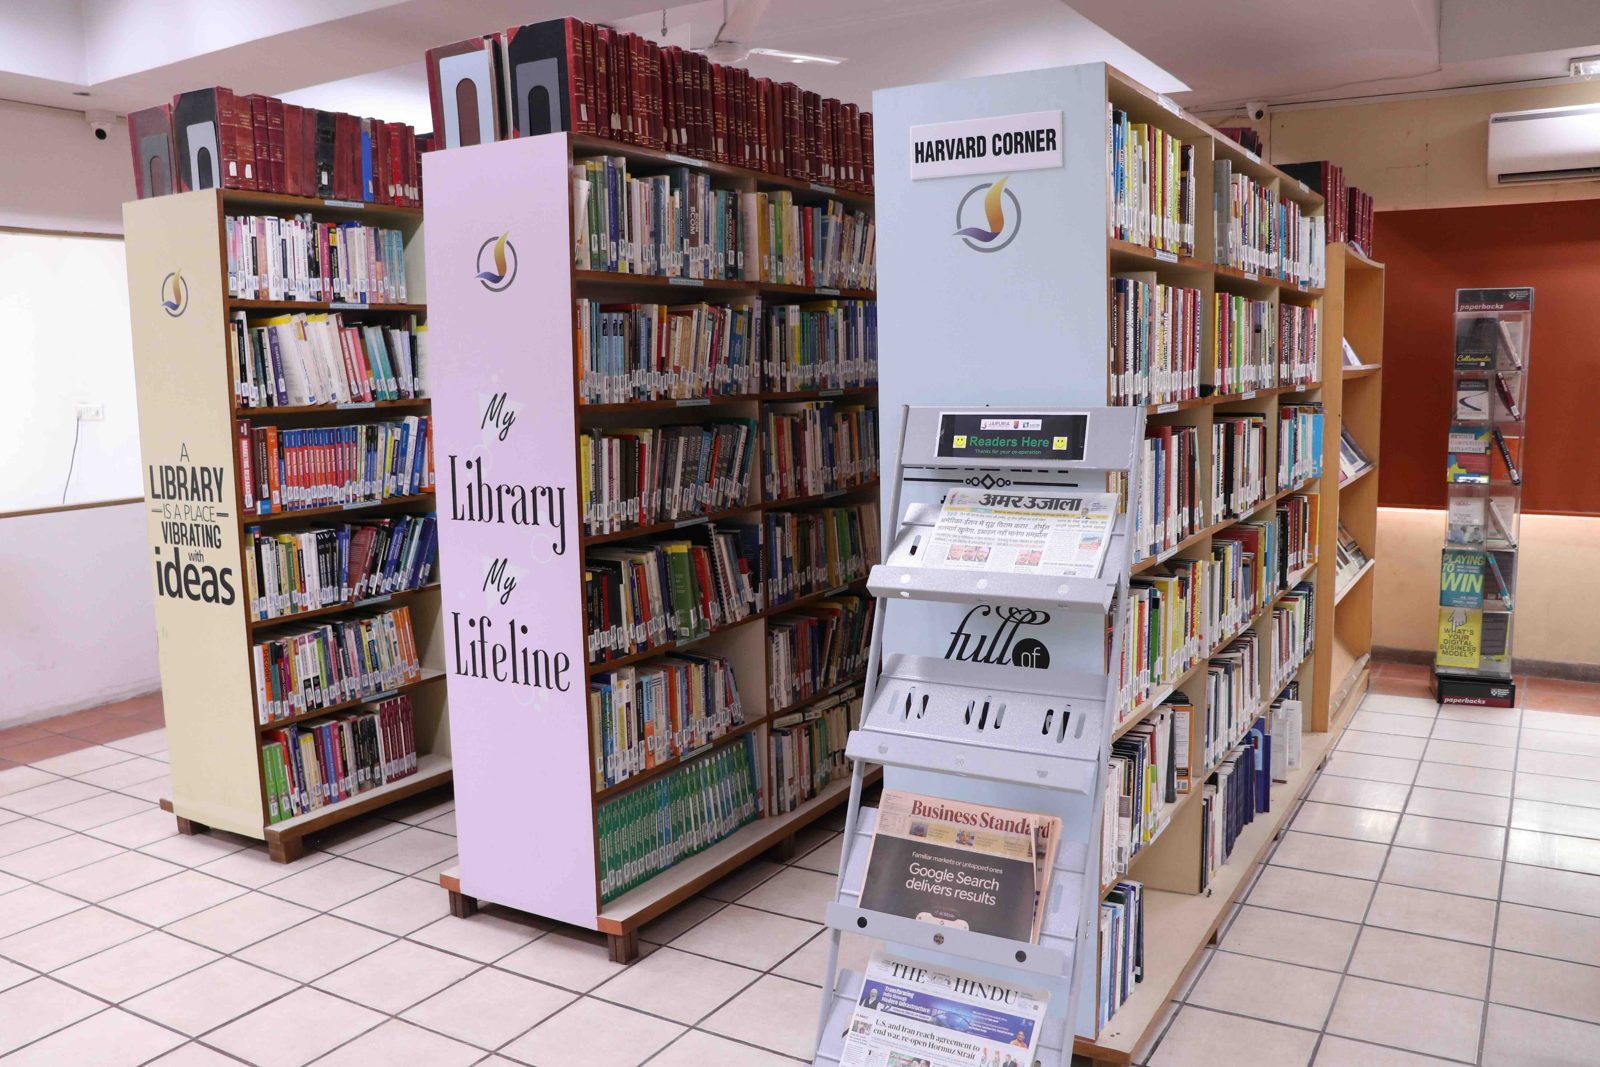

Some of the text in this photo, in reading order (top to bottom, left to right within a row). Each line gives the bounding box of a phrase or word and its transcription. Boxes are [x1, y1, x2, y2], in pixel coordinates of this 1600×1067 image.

[914, 128, 1057, 164] HARVARD CORNER
[1459, 303, 1505, 312] paperbacks
[481, 392, 516, 442] My
[180, 442, 190, 462] A
[969, 436, 1050, 448] Readers Here
[149, 465, 224, 503] LIBRARY
[162, 503, 216, 523] IS A PLACE
[448, 455, 566, 556] Library
[979, 494, 1024, 508] अमर
[1023, 496, 1082, 511] उजाला
[161, 521, 222, 549] VIBRATING
[188, 550, 205, 562] with
[1442, 563, 1455, 573] TO
[1443, 554, 1485, 566] PLAYING
[155, 546, 235, 606] ideas
[482, 558, 517, 605] My
[1441, 572, 1484, 593] WIN
[944, 604, 1050, 668] full of
[1443, 628, 1474, 636] WHAT'S
[1443, 639, 1473, 647] DIGITAL
[451, 611, 571, 692] Lifeline
[1440, 644, 1477, 653] BUSINESS
[1443, 697, 1486, 705] paperbacks
[911, 799, 978, 826] Business
[912, 851, 933, 860] Familiar
[932, 855, 955, 865] markets
[962, 861, 990, 872] untapped
[909, 862, 1000, 892] Google Search
[905, 877, 997, 906] delivers results
[885, 986, 915, 999] Transforming
[890, 961, 1018, 1006] THE HINDU
[873, 1027, 887, 1037] end
[887, 1032, 900, 1041] war,
[901, 1034, 928, 1047] re-open
[928, 1040, 956, 1055] Hormuz
[956, 1048, 977, 1060] Strait
[875, 1018, 887, 1027] U.S.
[887, 1022, 901, 1031] and
[901, 1025, 916, 1035] Iran
[916, 1029, 935, 1040] reach
[936, 1034, 971, 1050] agreement
